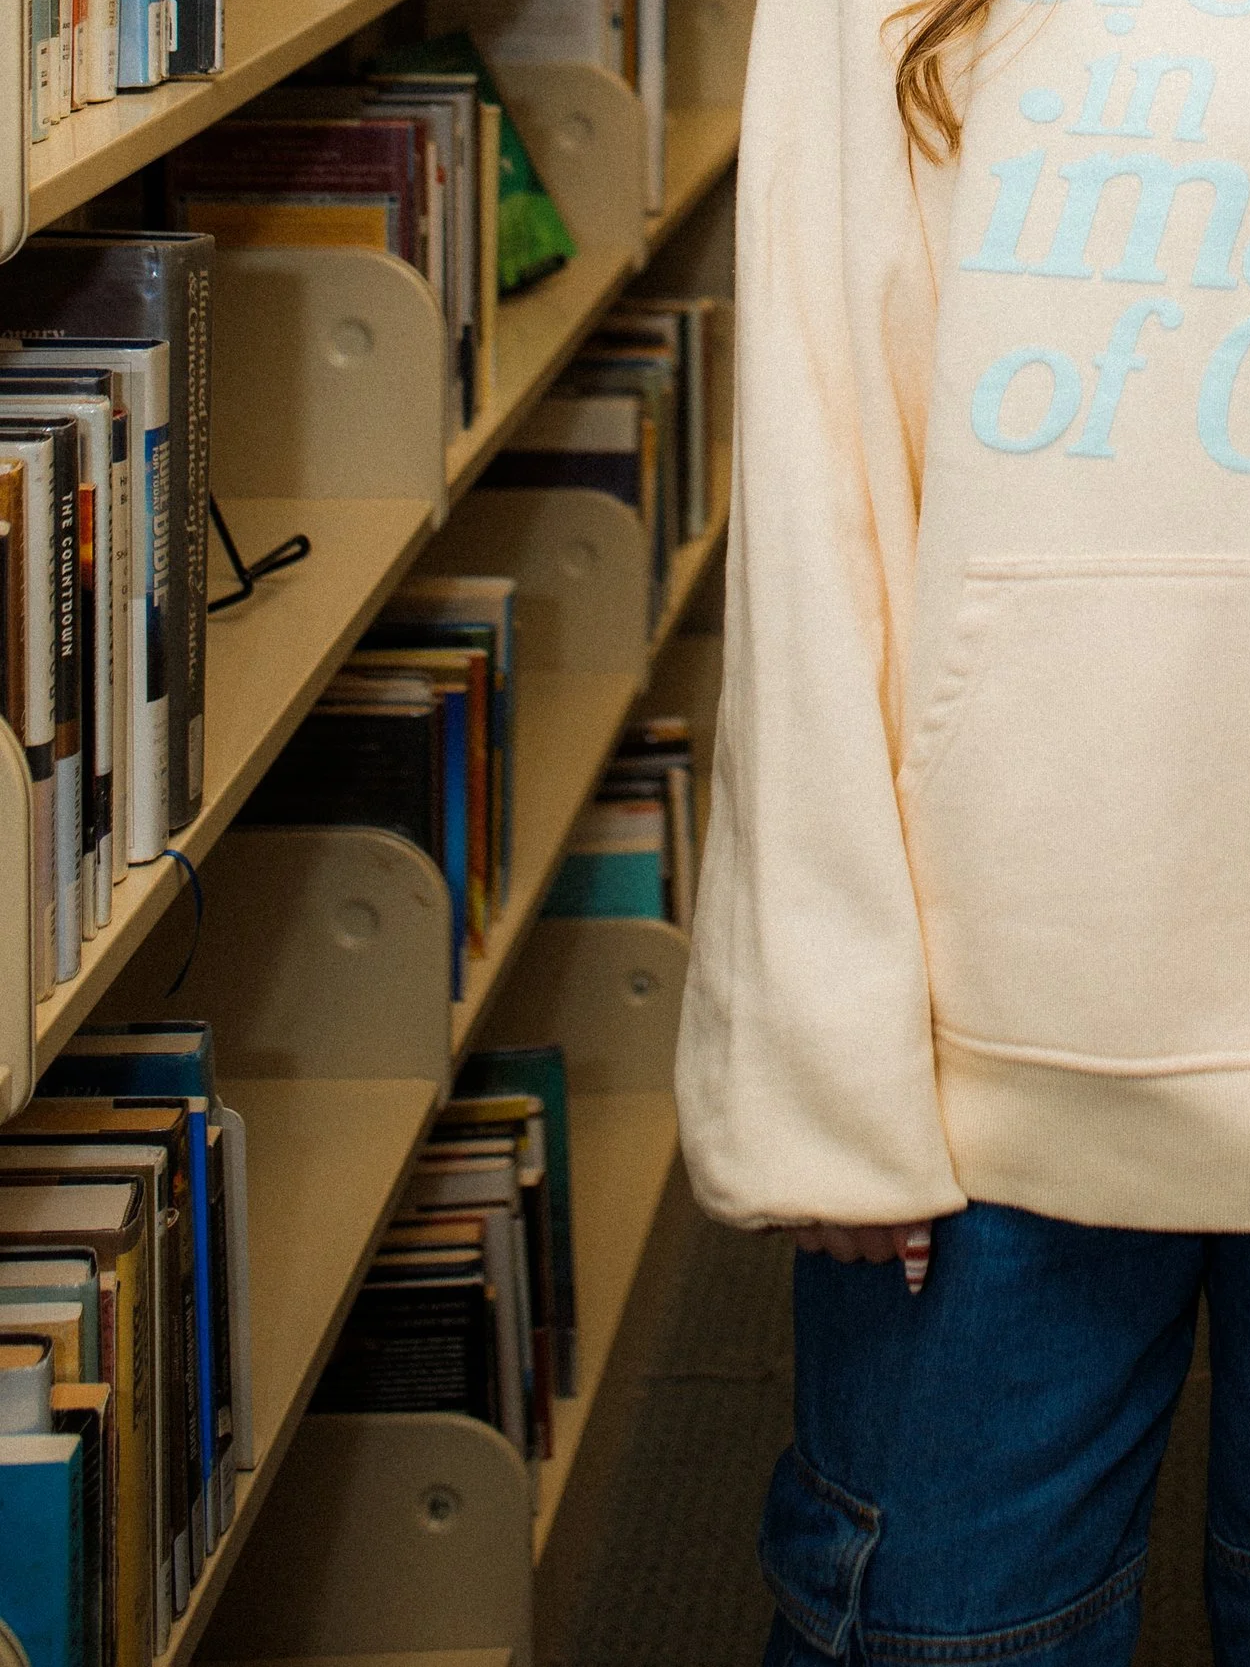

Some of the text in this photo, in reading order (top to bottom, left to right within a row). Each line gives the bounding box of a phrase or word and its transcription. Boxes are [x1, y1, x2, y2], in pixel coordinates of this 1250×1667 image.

[1066, 11, 1218, 144] in
[187, 307, 198, 493] Concordance
[194, 270, 209, 594] Illustrated Dictionary
[969, 297, 1183, 460] of
[152, 446, 160, 512] FOR TODAY
[184, 504, 198, 532] of
[61, 491, 74, 657] THE COUNTDOWN
[187, 545, 197, 592] the
